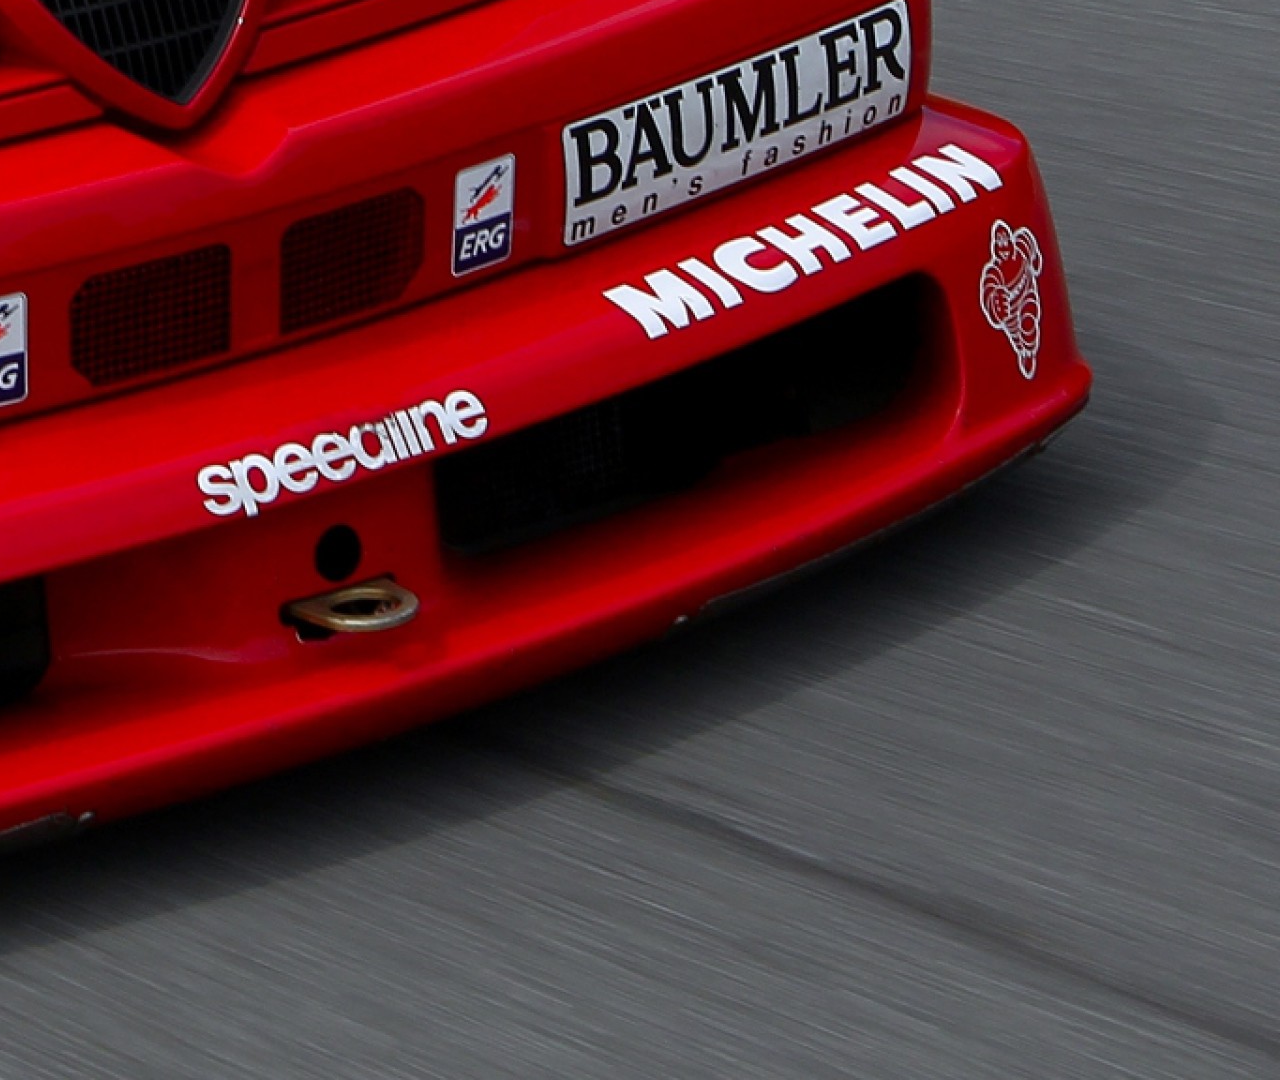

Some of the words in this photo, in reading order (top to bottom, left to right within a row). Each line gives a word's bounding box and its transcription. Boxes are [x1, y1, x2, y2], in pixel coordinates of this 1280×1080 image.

[570, 7, 906, 208] BÄUMLER
[571, 175, 704, 241] men's
[740, 92, 901, 175] fashion
[459, 222, 507, 261] ERG
[602, 143, 1004, 340] MICHELIN
[197, 389, 488, 518] speedline
